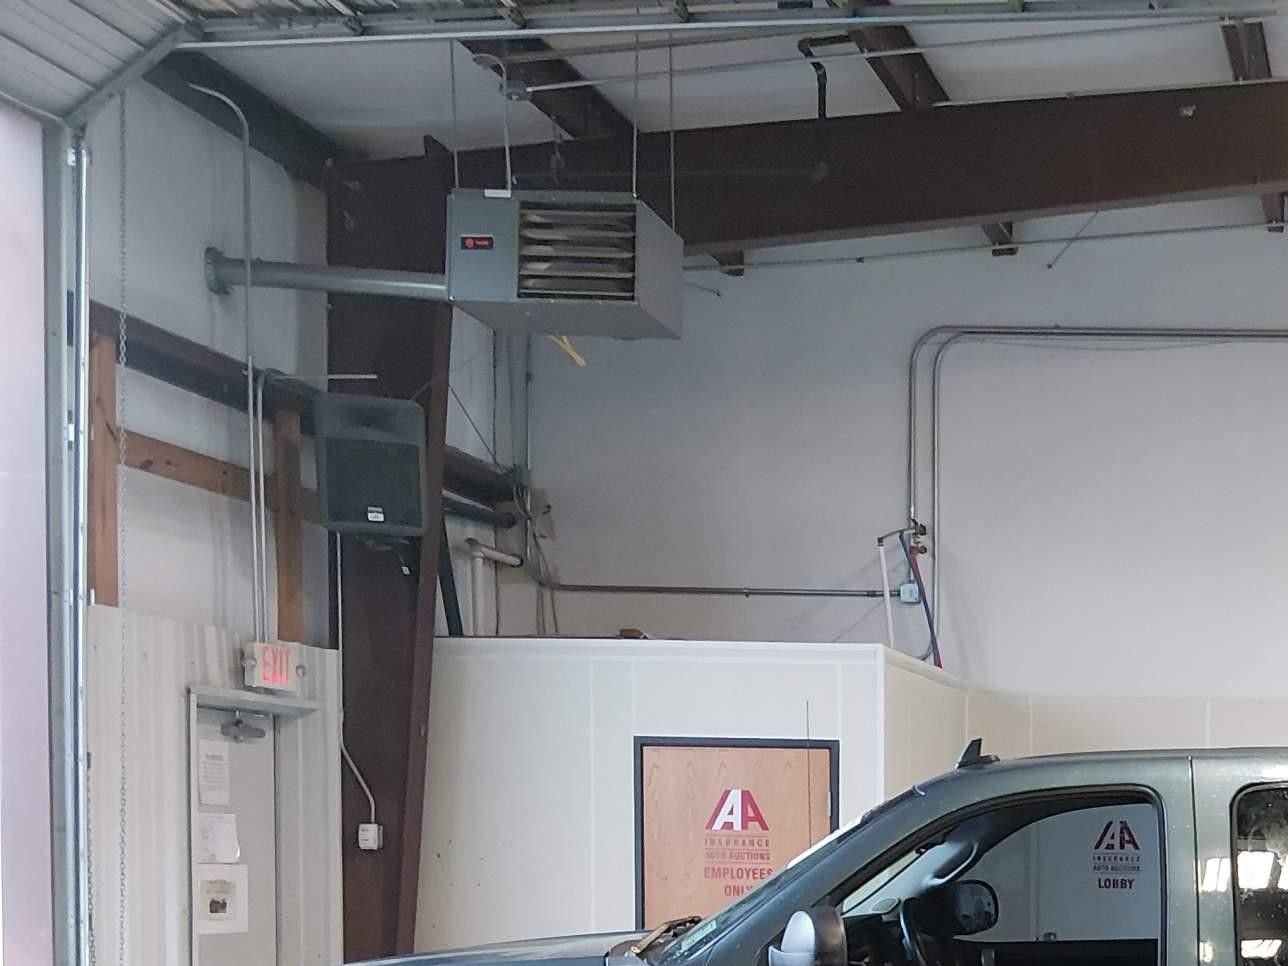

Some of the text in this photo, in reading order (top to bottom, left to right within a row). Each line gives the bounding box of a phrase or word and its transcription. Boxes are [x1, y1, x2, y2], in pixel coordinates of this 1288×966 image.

[262, 645, 289, 685] EXIT
[705, 838, 770, 848] INSURANCE
[729, 851, 770, 861] AUCTIONS
[704, 867, 774, 880] EMPLOYEES
[1098, 878, 1135, 889] LOBBY
